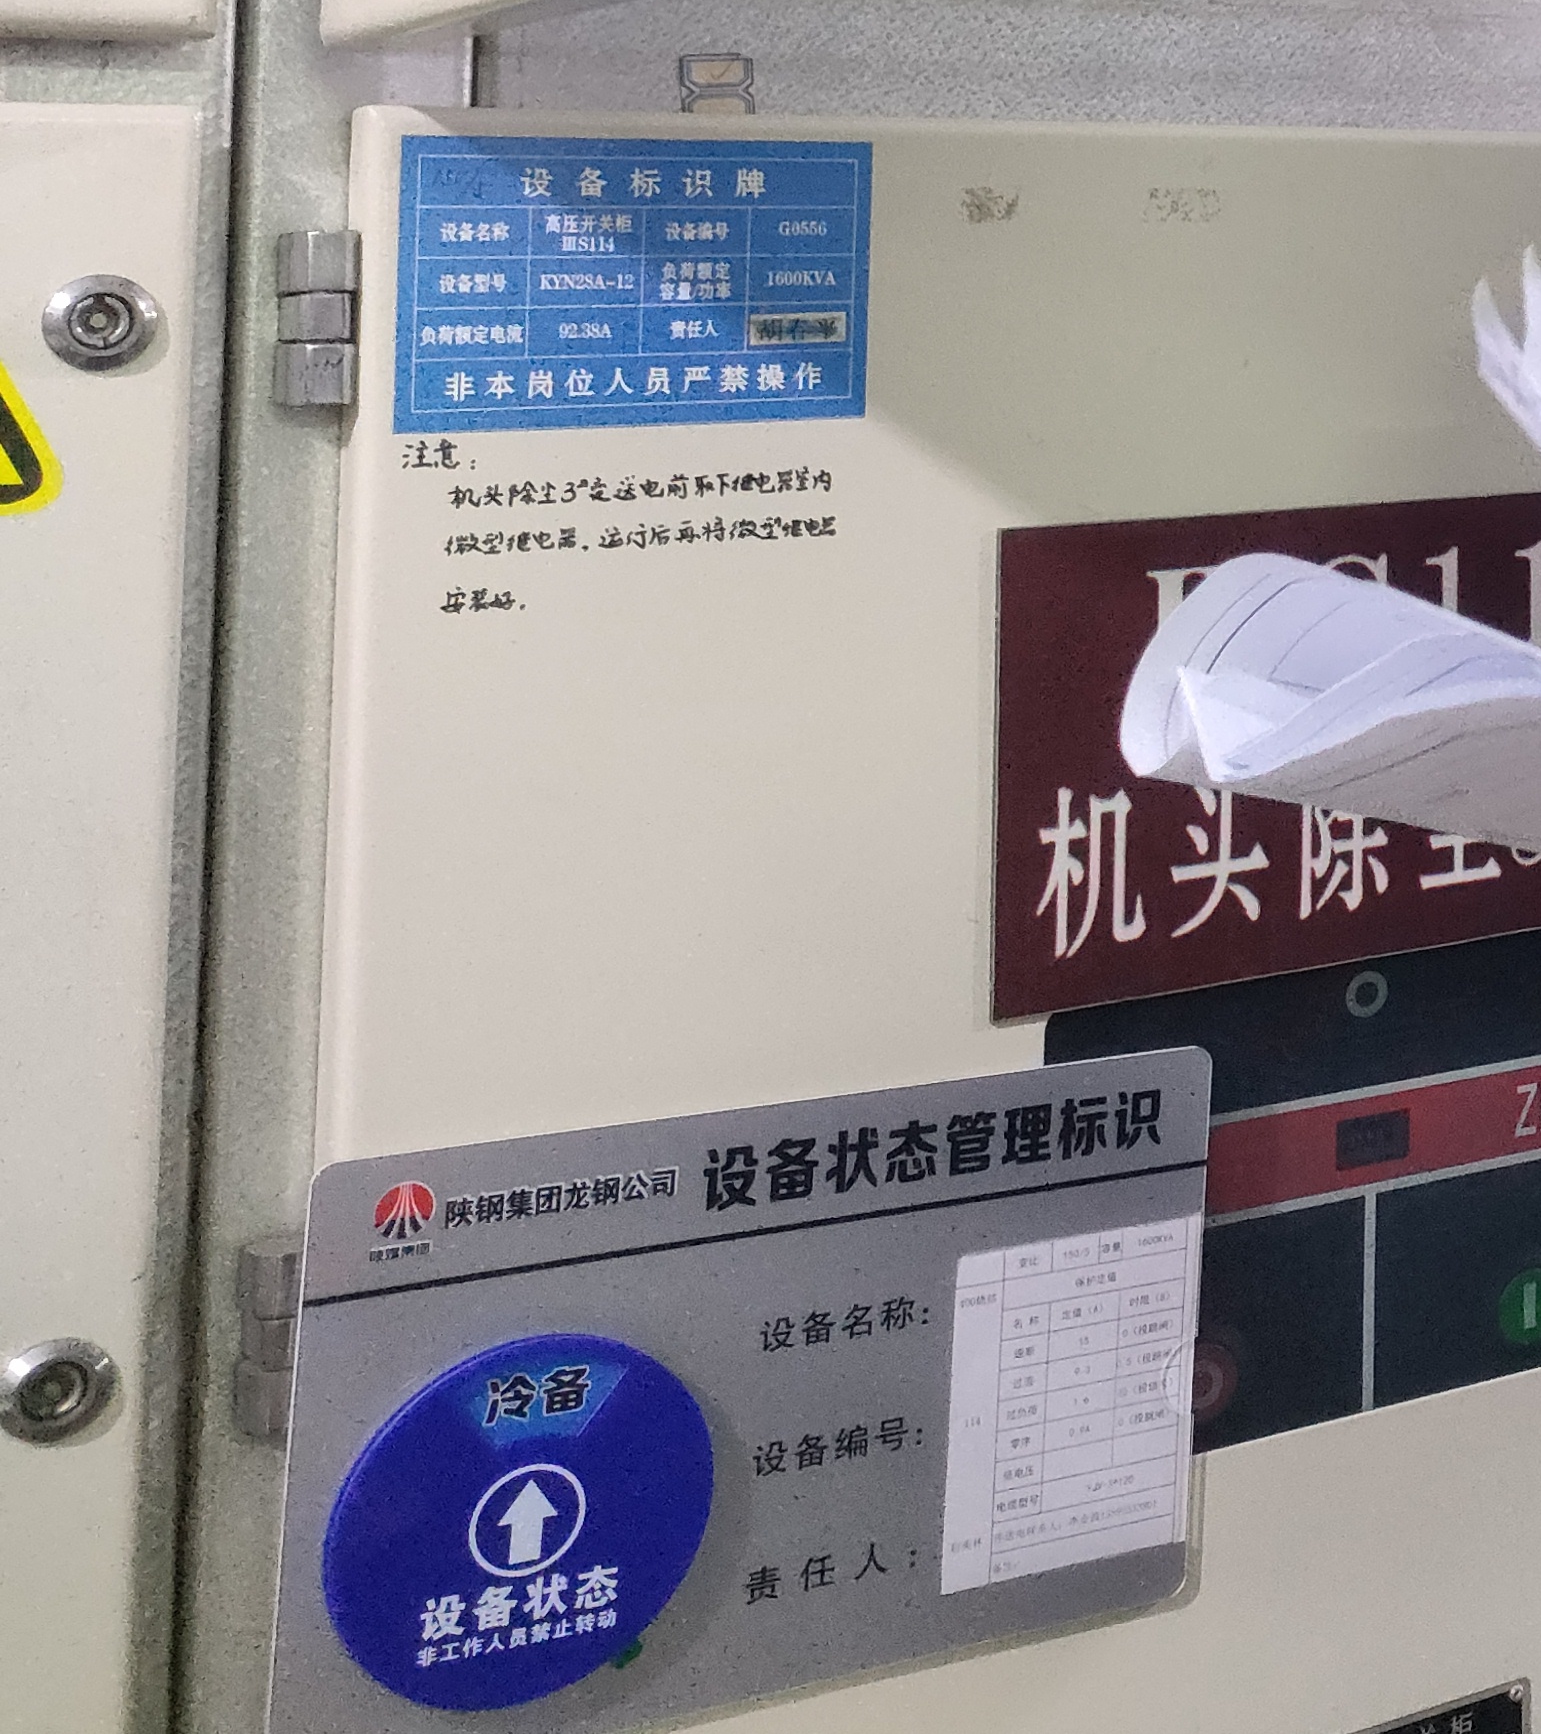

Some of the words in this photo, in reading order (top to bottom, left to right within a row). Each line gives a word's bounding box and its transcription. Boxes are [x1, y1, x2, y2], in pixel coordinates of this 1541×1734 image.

[520, 167, 767, 199] 设备标识牌
[440, 222, 511, 243] 设备名称
[545, 213, 633, 235] 高压开关柜
[665, 223, 730, 242] 设备编号
[439, 273, 507, 295] 设备型号
[539, 274, 635, 291] KYN28A-12
[767, 271, 836, 287] 1600KVA
[420, 322, 525, 347] 负荷额定电流
[558, 322, 613, 340] 92.38A
[669, 319, 721, 339] 责任人
[445, 363, 824, 402] 非本岗位人员严禁操作
[444, 1166, 679, 1229] 陕钢集团龙钢公司
[703, 1089, 1162, 1212] 设备状态管理标识
[760, 1296, 929, 1352] 设备名称：
[482, 1364, 590, 1428] 冷备
[752, 1417, 923, 1478] 设备编号：
[743, 1543, 918, 1606] 责任人：
[420, 1565, 619, 1641] 设备状态
[415, 1608, 618, 1668] 非工作人员禁止转动
